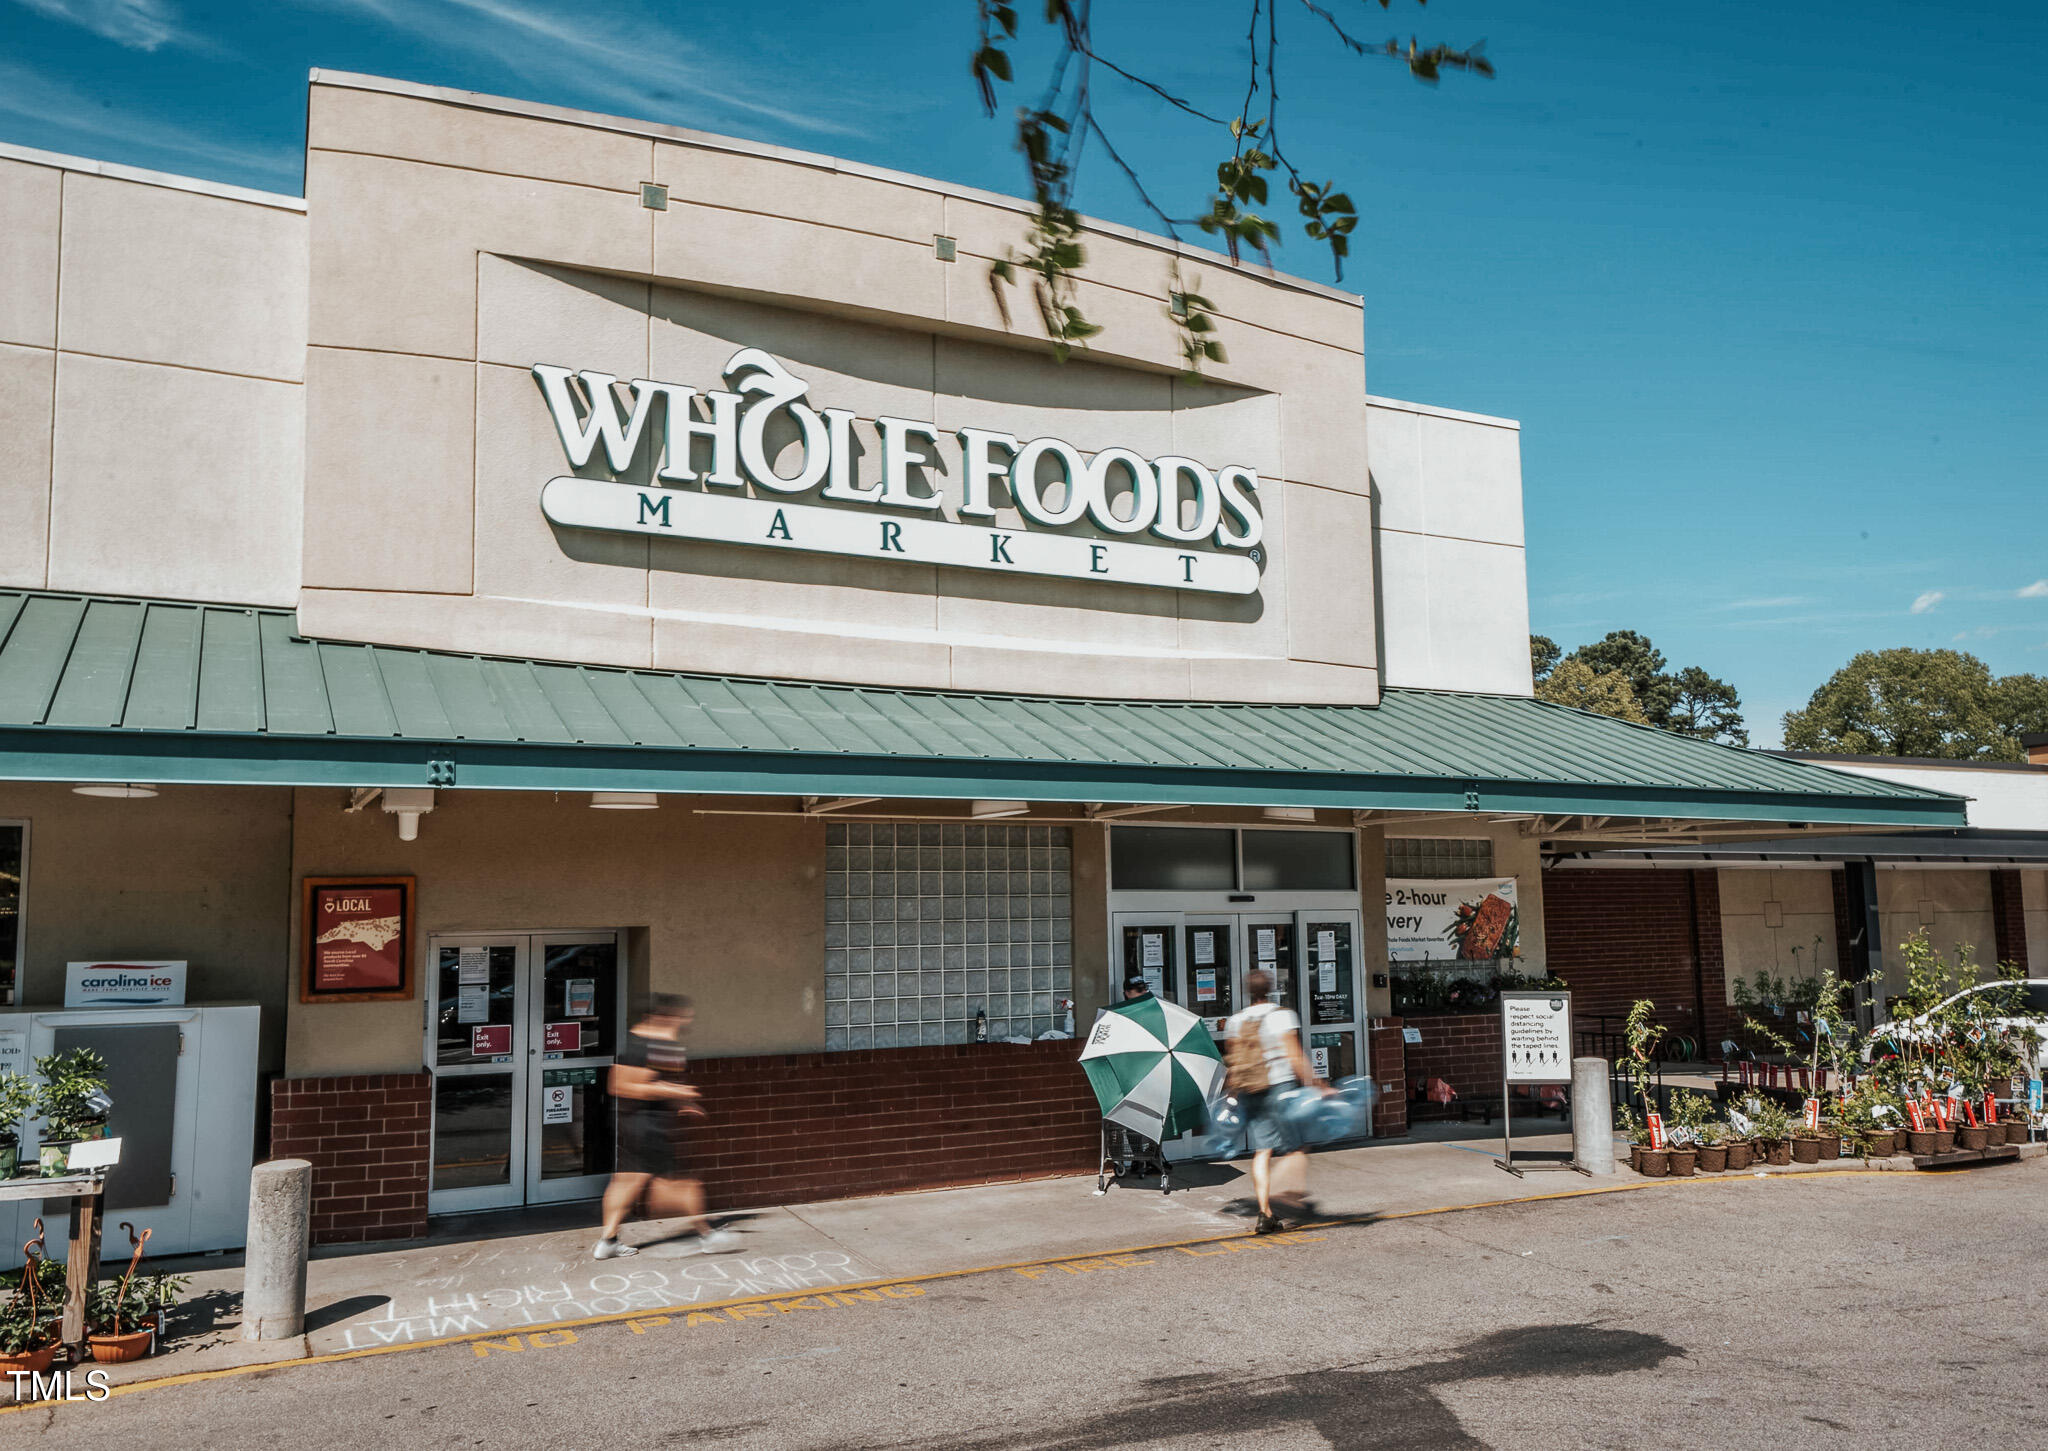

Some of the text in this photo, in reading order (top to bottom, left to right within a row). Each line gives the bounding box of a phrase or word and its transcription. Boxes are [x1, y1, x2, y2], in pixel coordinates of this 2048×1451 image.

[531, 347, 1263, 548] WHOLE FOODS
[637, 492, 1198, 583] MARKET
[336, 898, 372, 912] LOCAL
[1396, 888, 1447, 906] 2-hour
[81, 974, 172, 987] carolina ice
[476, 1041, 492, 1049] only.
[682, 1251, 850, 1280] COULD
[472, 1231, 1328, 1357] NO PARKING FIRE LANE
[590, 1270, 669, 1294] GO
[332, 1267, 880, 1350] THINK ABOUT WHAT
